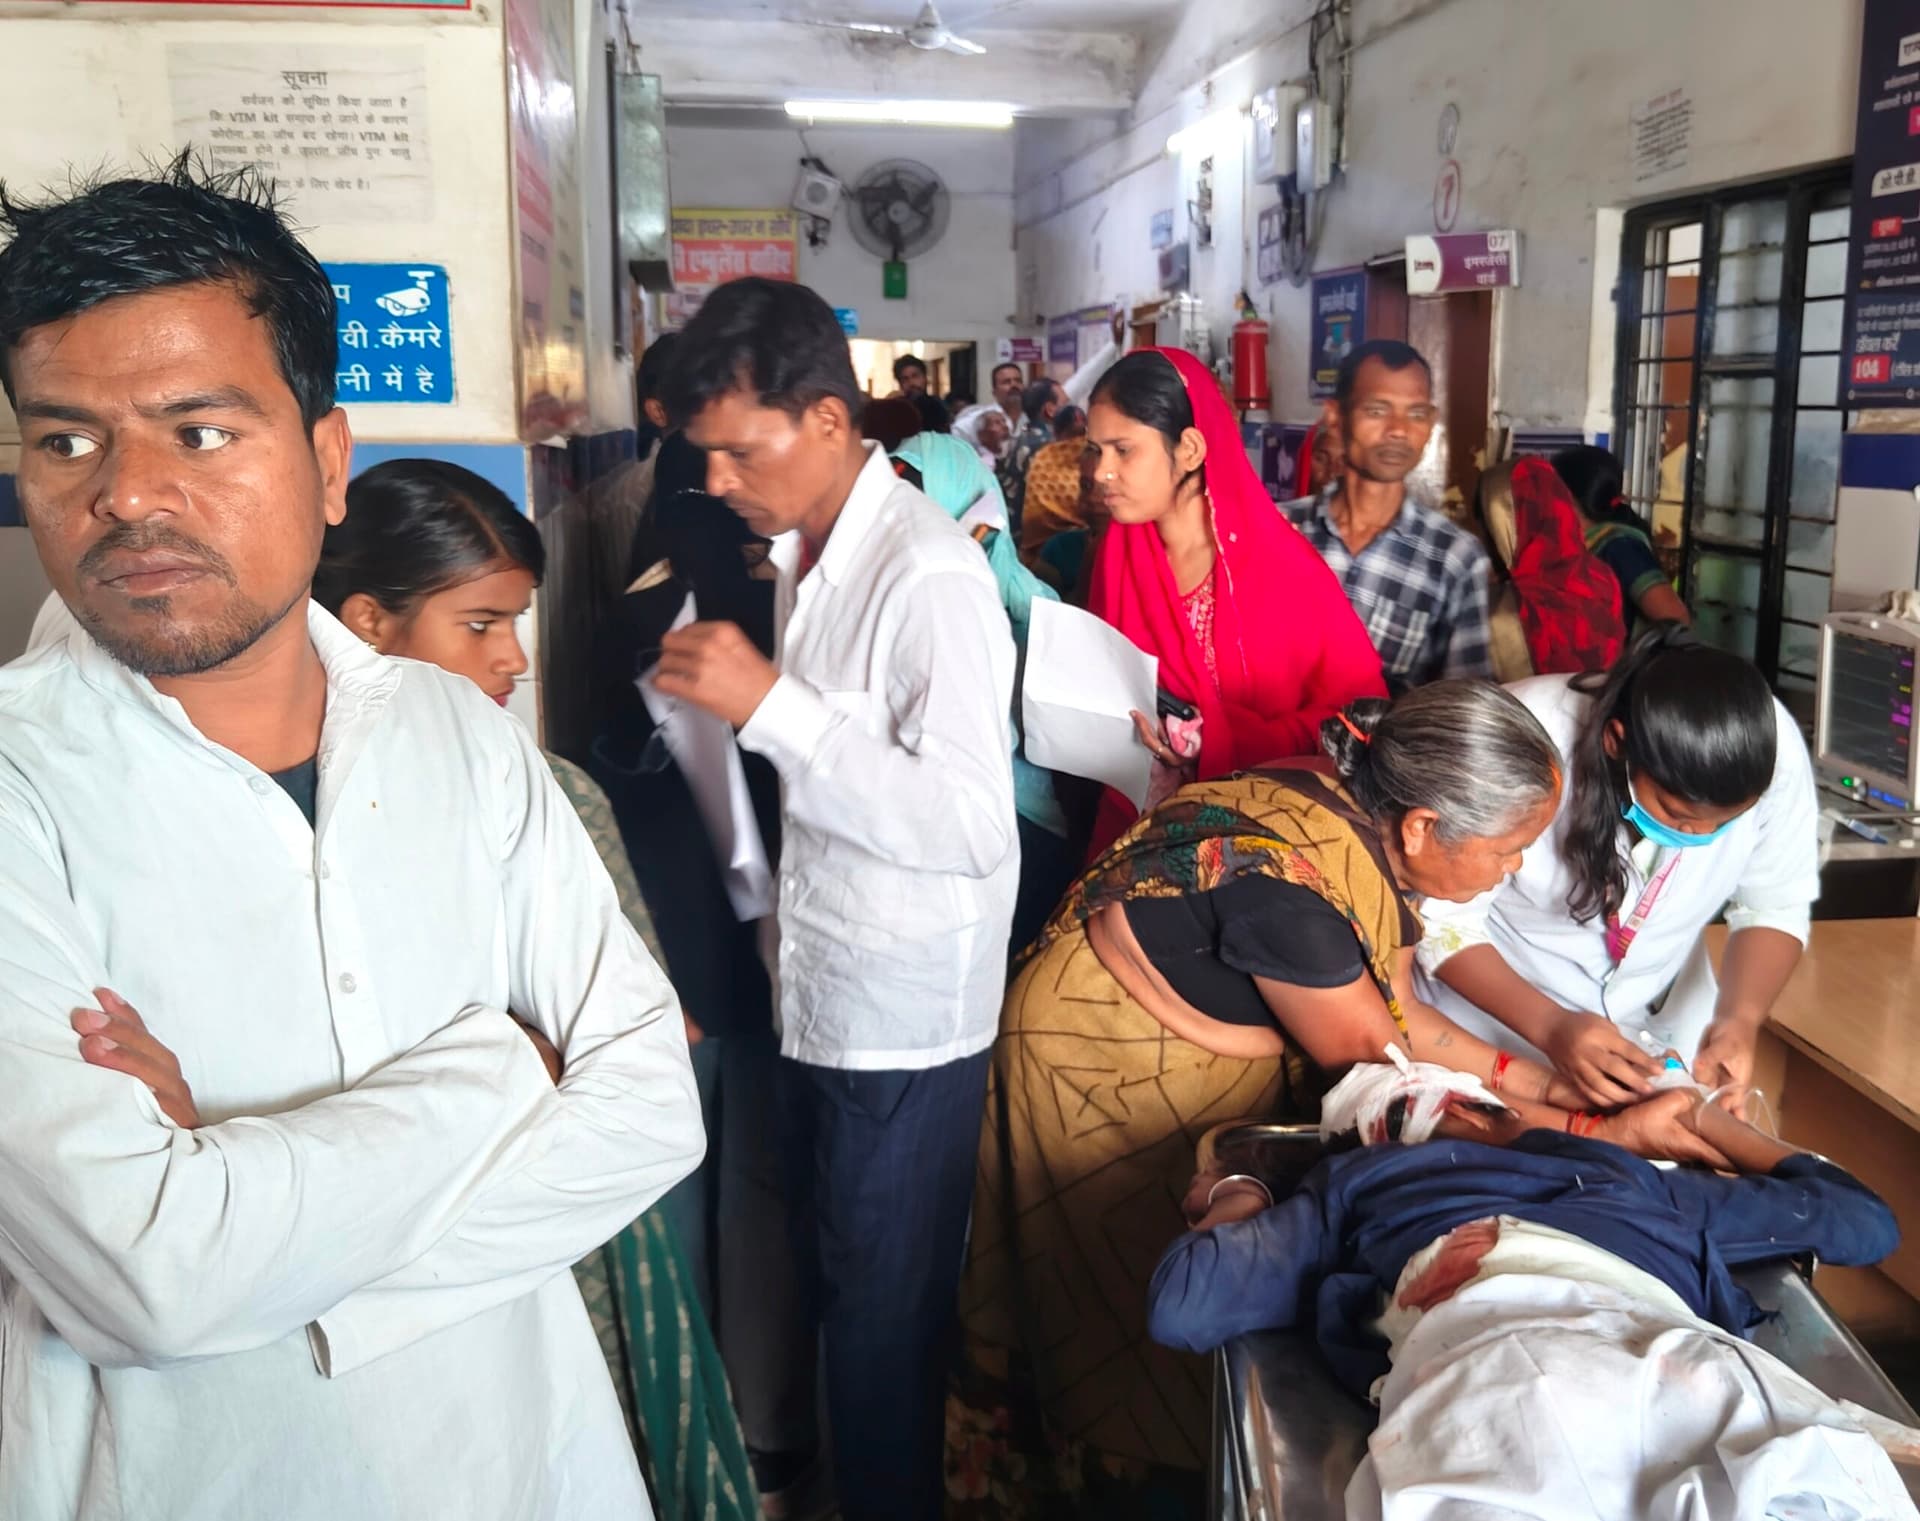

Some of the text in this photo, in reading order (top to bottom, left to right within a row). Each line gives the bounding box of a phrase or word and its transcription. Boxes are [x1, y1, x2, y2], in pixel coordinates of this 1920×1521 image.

[281, 70, 328, 90] सूचना
[282, 94, 295, 106] को
[303, 94, 330, 109] सूचित
[338, 94, 362, 106] किया
[369, 97, 393, 107] जाता
[229, 112, 257, 123] VTM
[263, 112, 279, 123] kit
[322, 112, 332, 125] हो
[359, 132, 386, 142] VTM
[394, 132, 409, 142] kit
[1489, 235, 1506, 248] 07
[332, 284, 350, 304] प
[1855, 358, 1880, 379] 104
[381, 363, 404, 392] में
[415, 363, 434, 394] है
